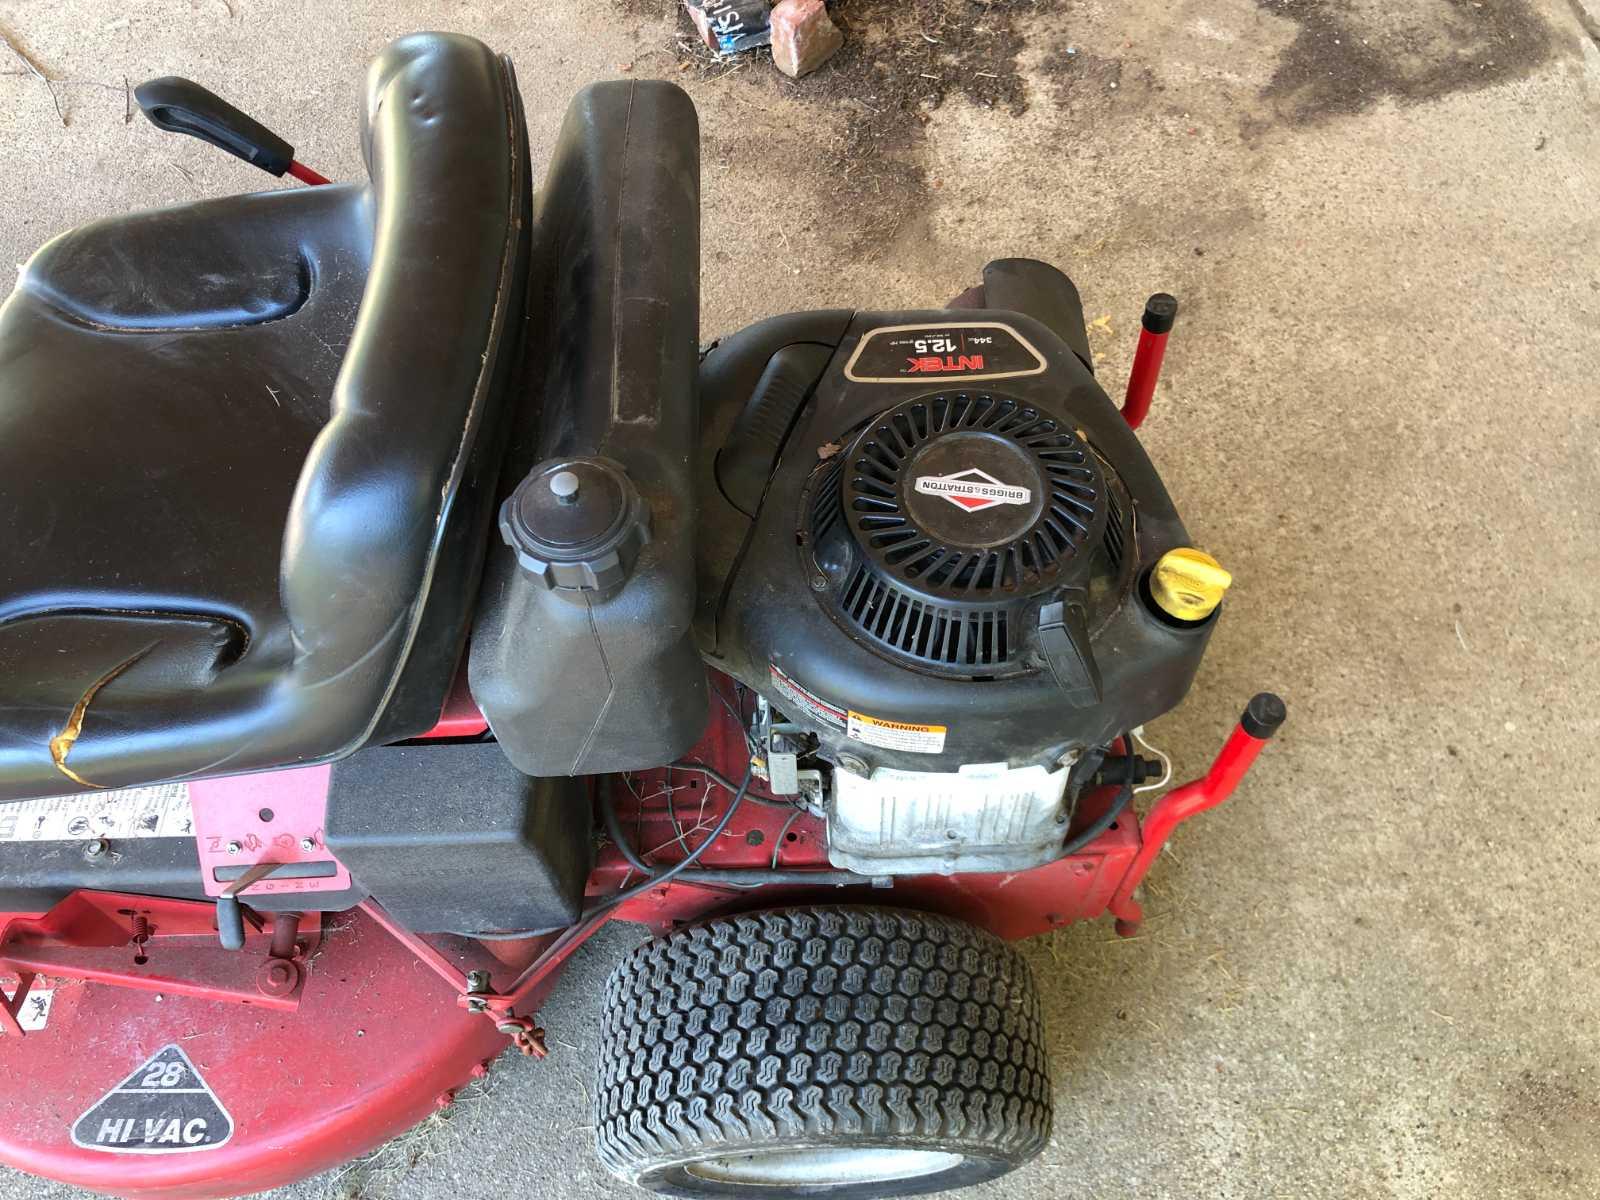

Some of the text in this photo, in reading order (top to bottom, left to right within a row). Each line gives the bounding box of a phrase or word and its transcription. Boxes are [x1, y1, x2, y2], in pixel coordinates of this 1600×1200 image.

[914, 338, 957, 354] 12.5
[906, 355, 983, 373] INTEK
[872, 719, 930, 733] WARNING
[141, 1061, 184, 1087] 28
[96, 1118, 135, 1143] HI
